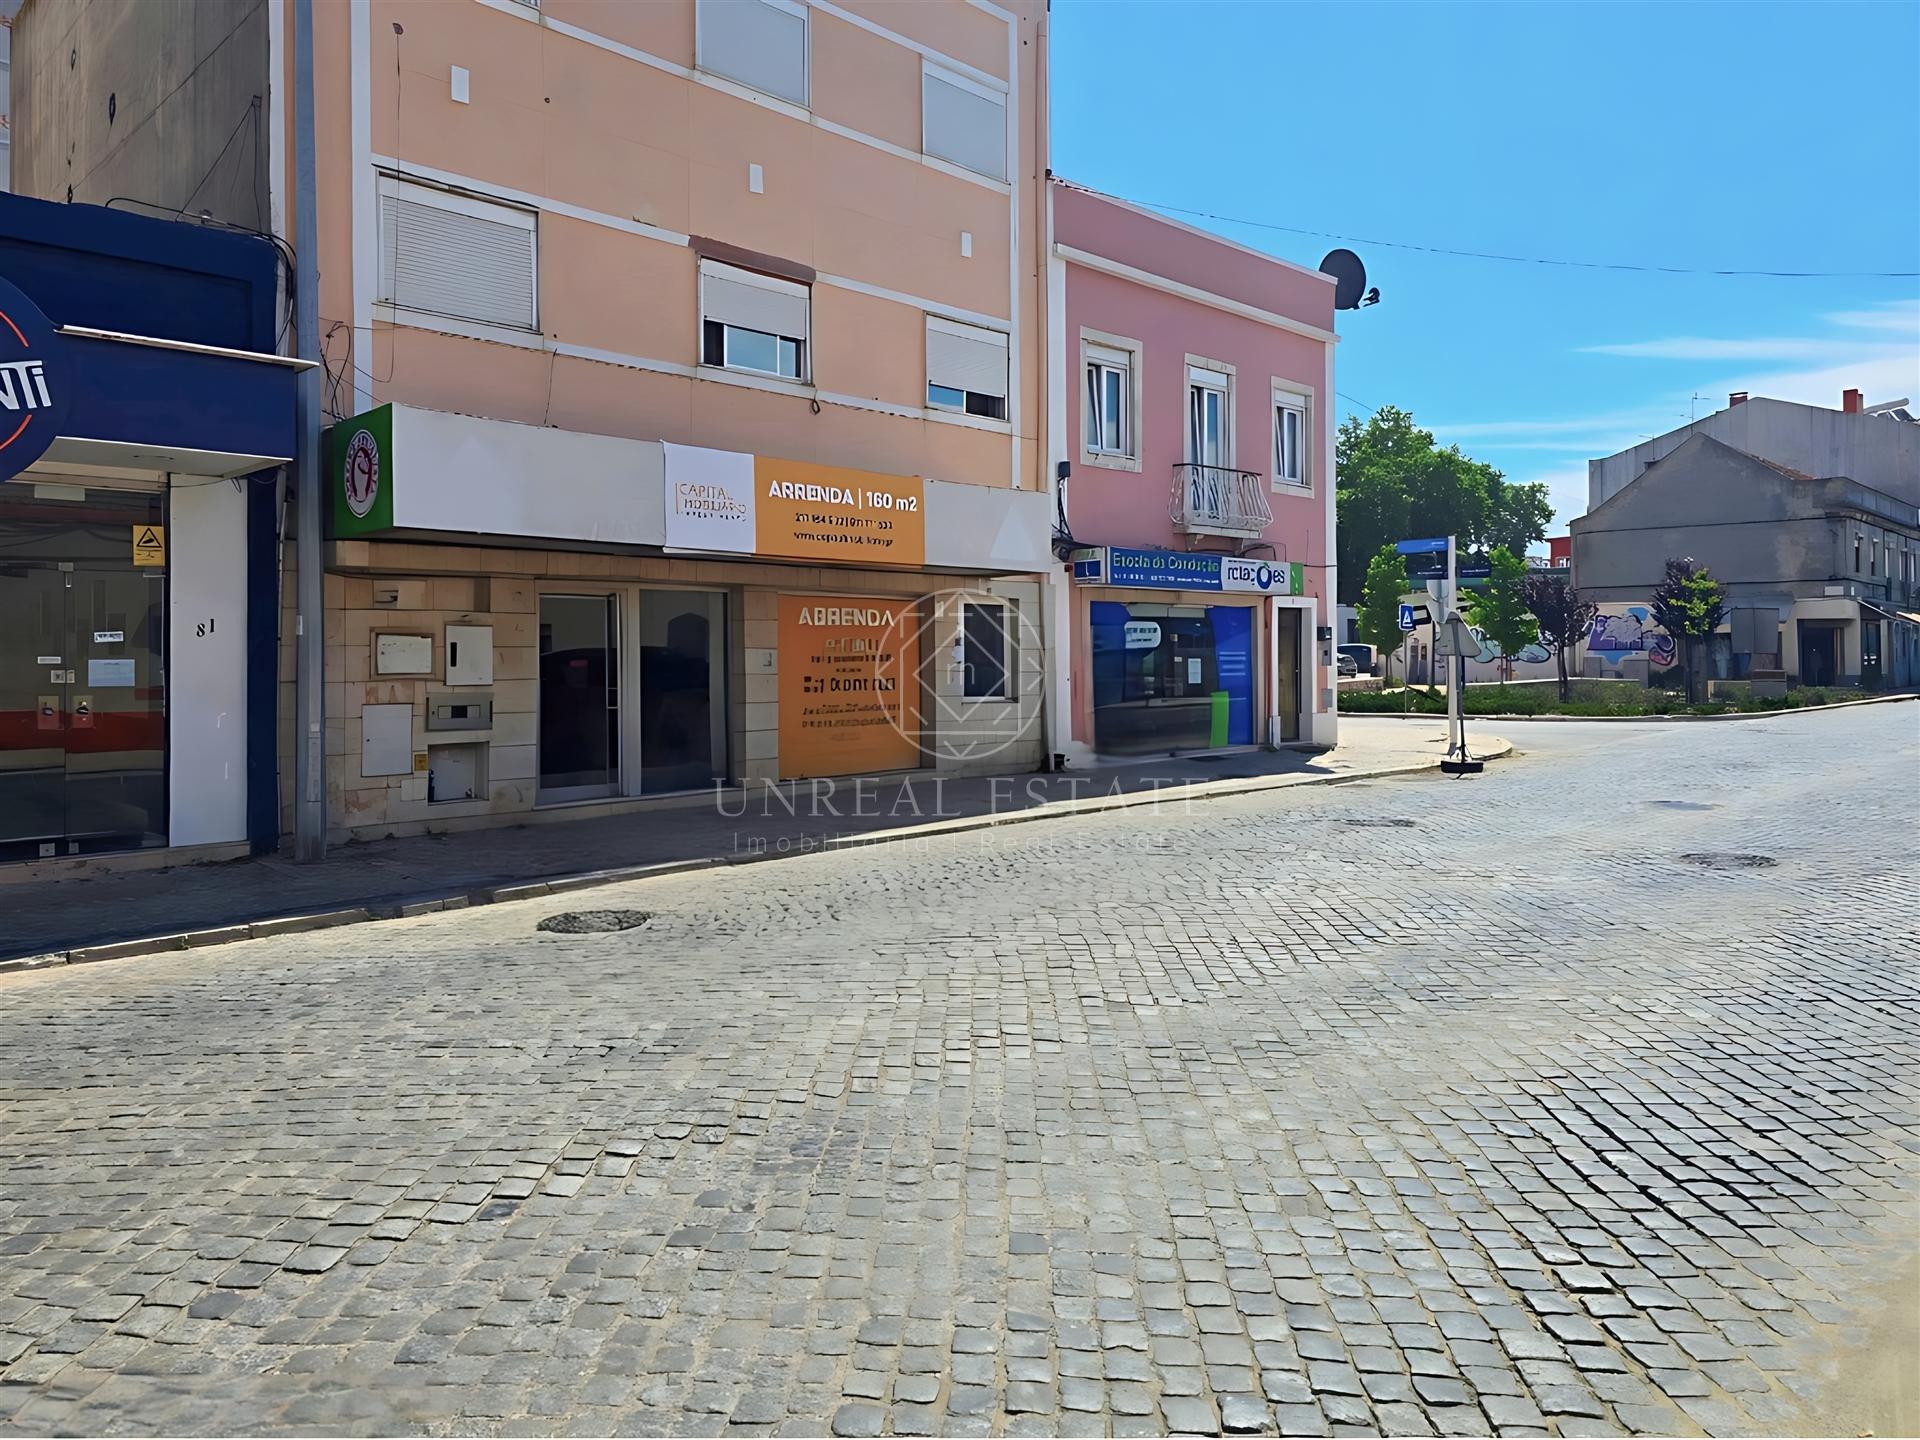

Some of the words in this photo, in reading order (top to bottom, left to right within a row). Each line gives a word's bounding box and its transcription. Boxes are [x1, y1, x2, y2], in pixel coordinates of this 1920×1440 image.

[768, 480, 855, 505] ARRENDA
[866, 491, 893, 509] 160
[896, 496, 918, 512] m2
[196, 618, 215, 638] 81
